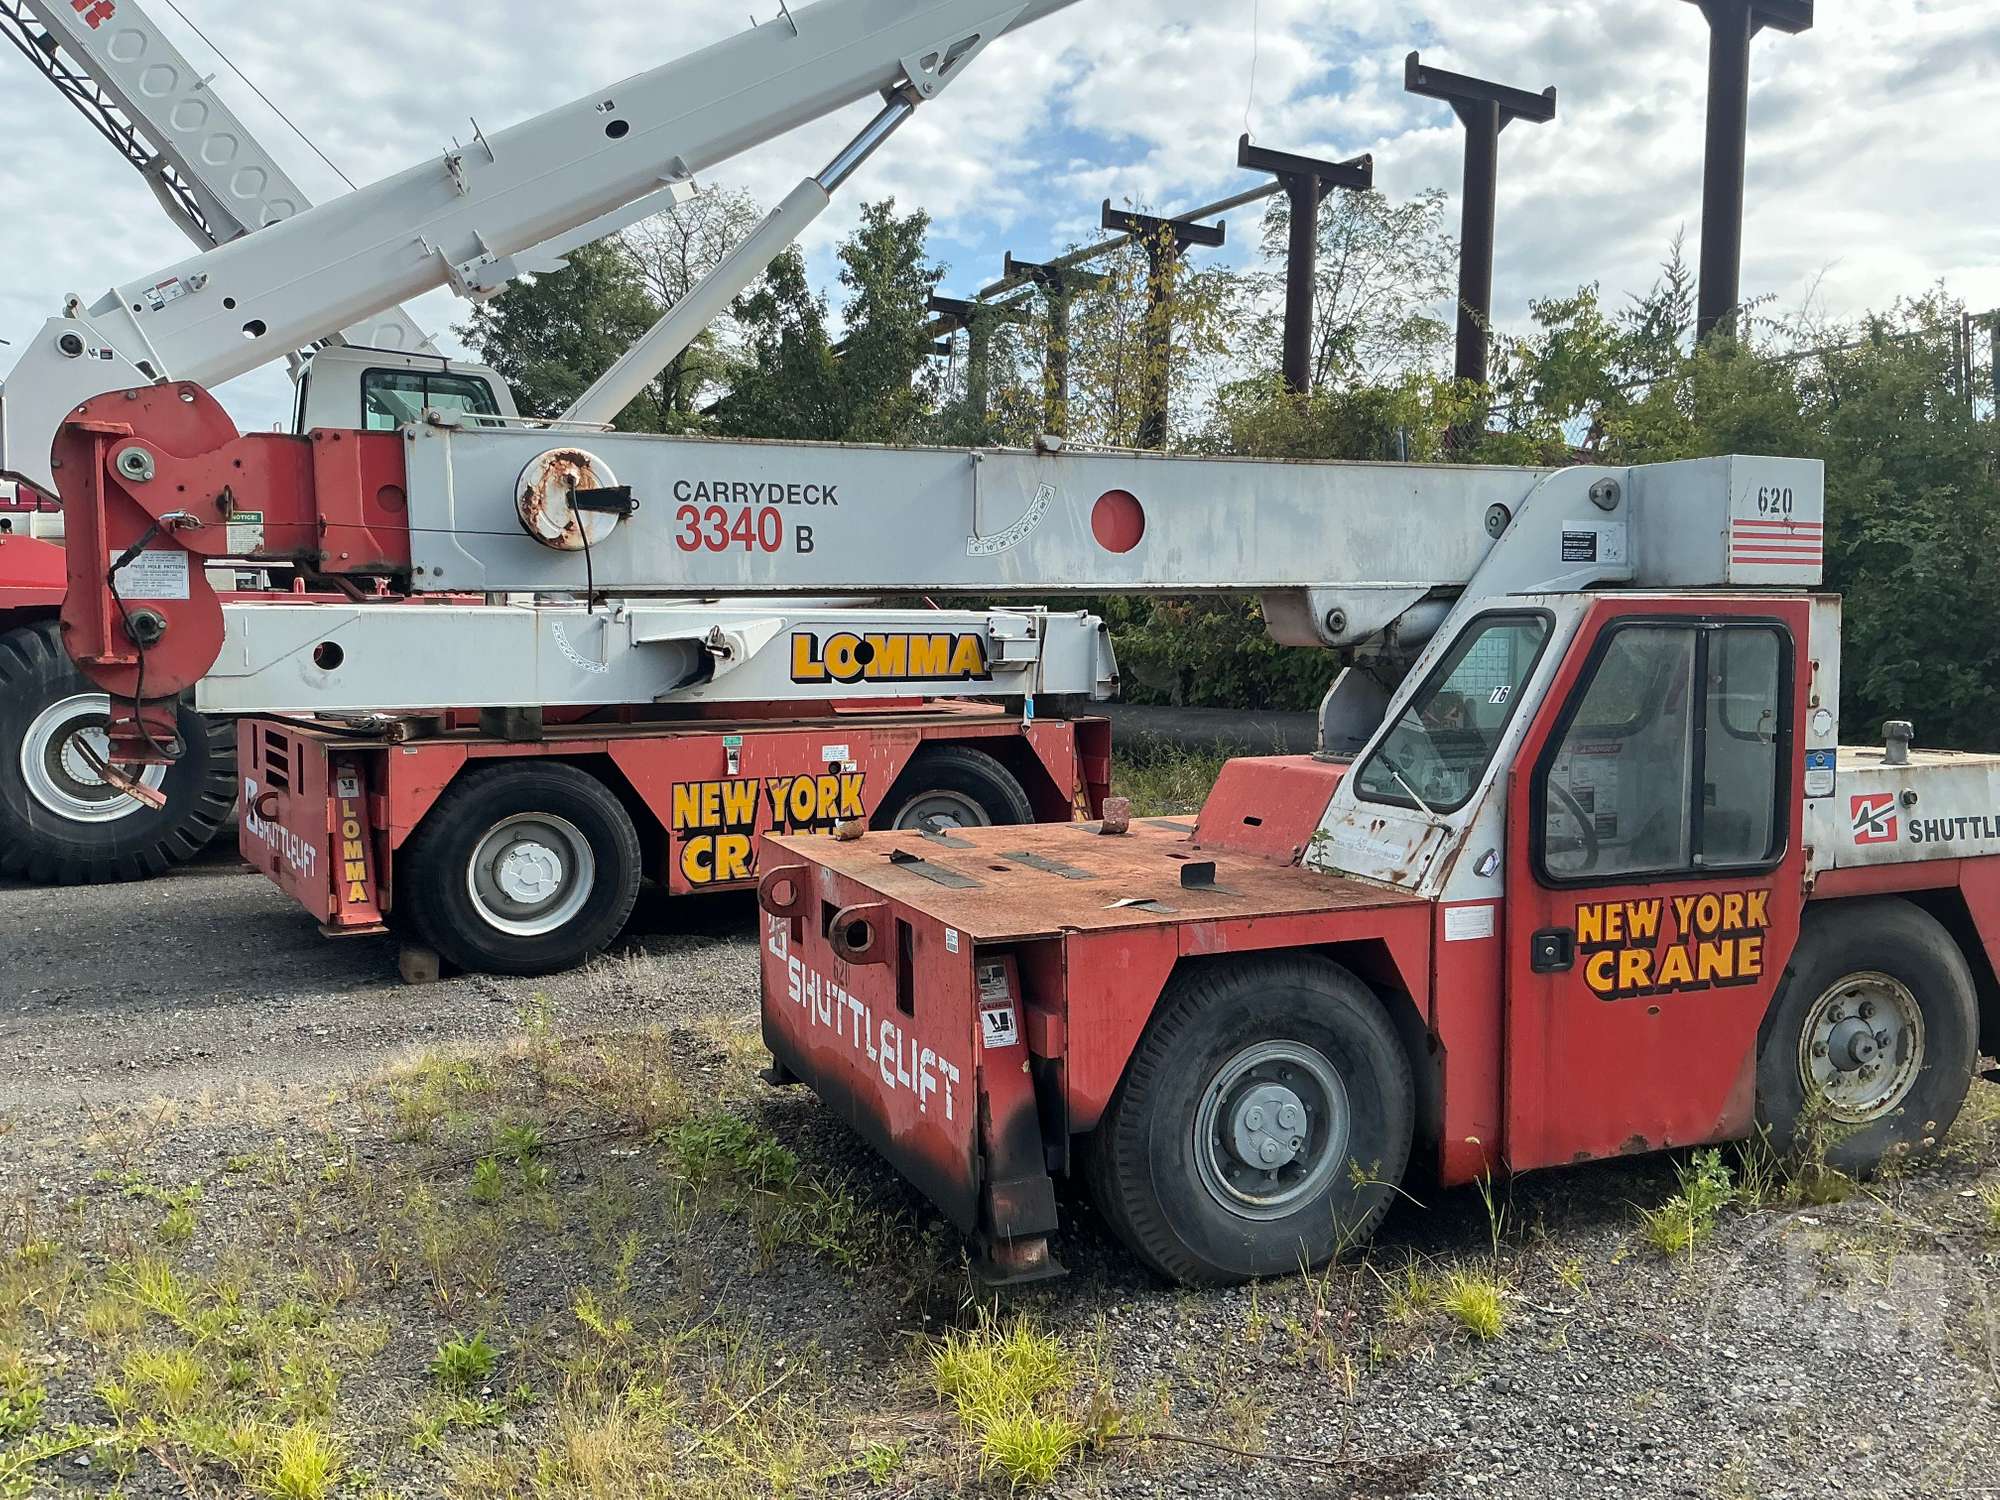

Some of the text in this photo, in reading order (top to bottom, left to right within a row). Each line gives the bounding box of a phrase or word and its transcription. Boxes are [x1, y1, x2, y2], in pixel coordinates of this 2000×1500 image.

[673, 480, 839, 505] CARRYDECK
[1758, 486, 1793, 514] 620
[675, 504, 815, 553] 3340 B
[791, 632, 991, 684] LOMMA
[1490, 686, 1509, 703] 76
[672, 772, 866, 836] NEW YORK
[342, 799, 369, 903] LOMMA
[1576, 889, 1772, 947] NEW YORK
[1584, 937, 1764, 997] CRANE
[786, 955, 961, 1121] SHUTTLELIFT
